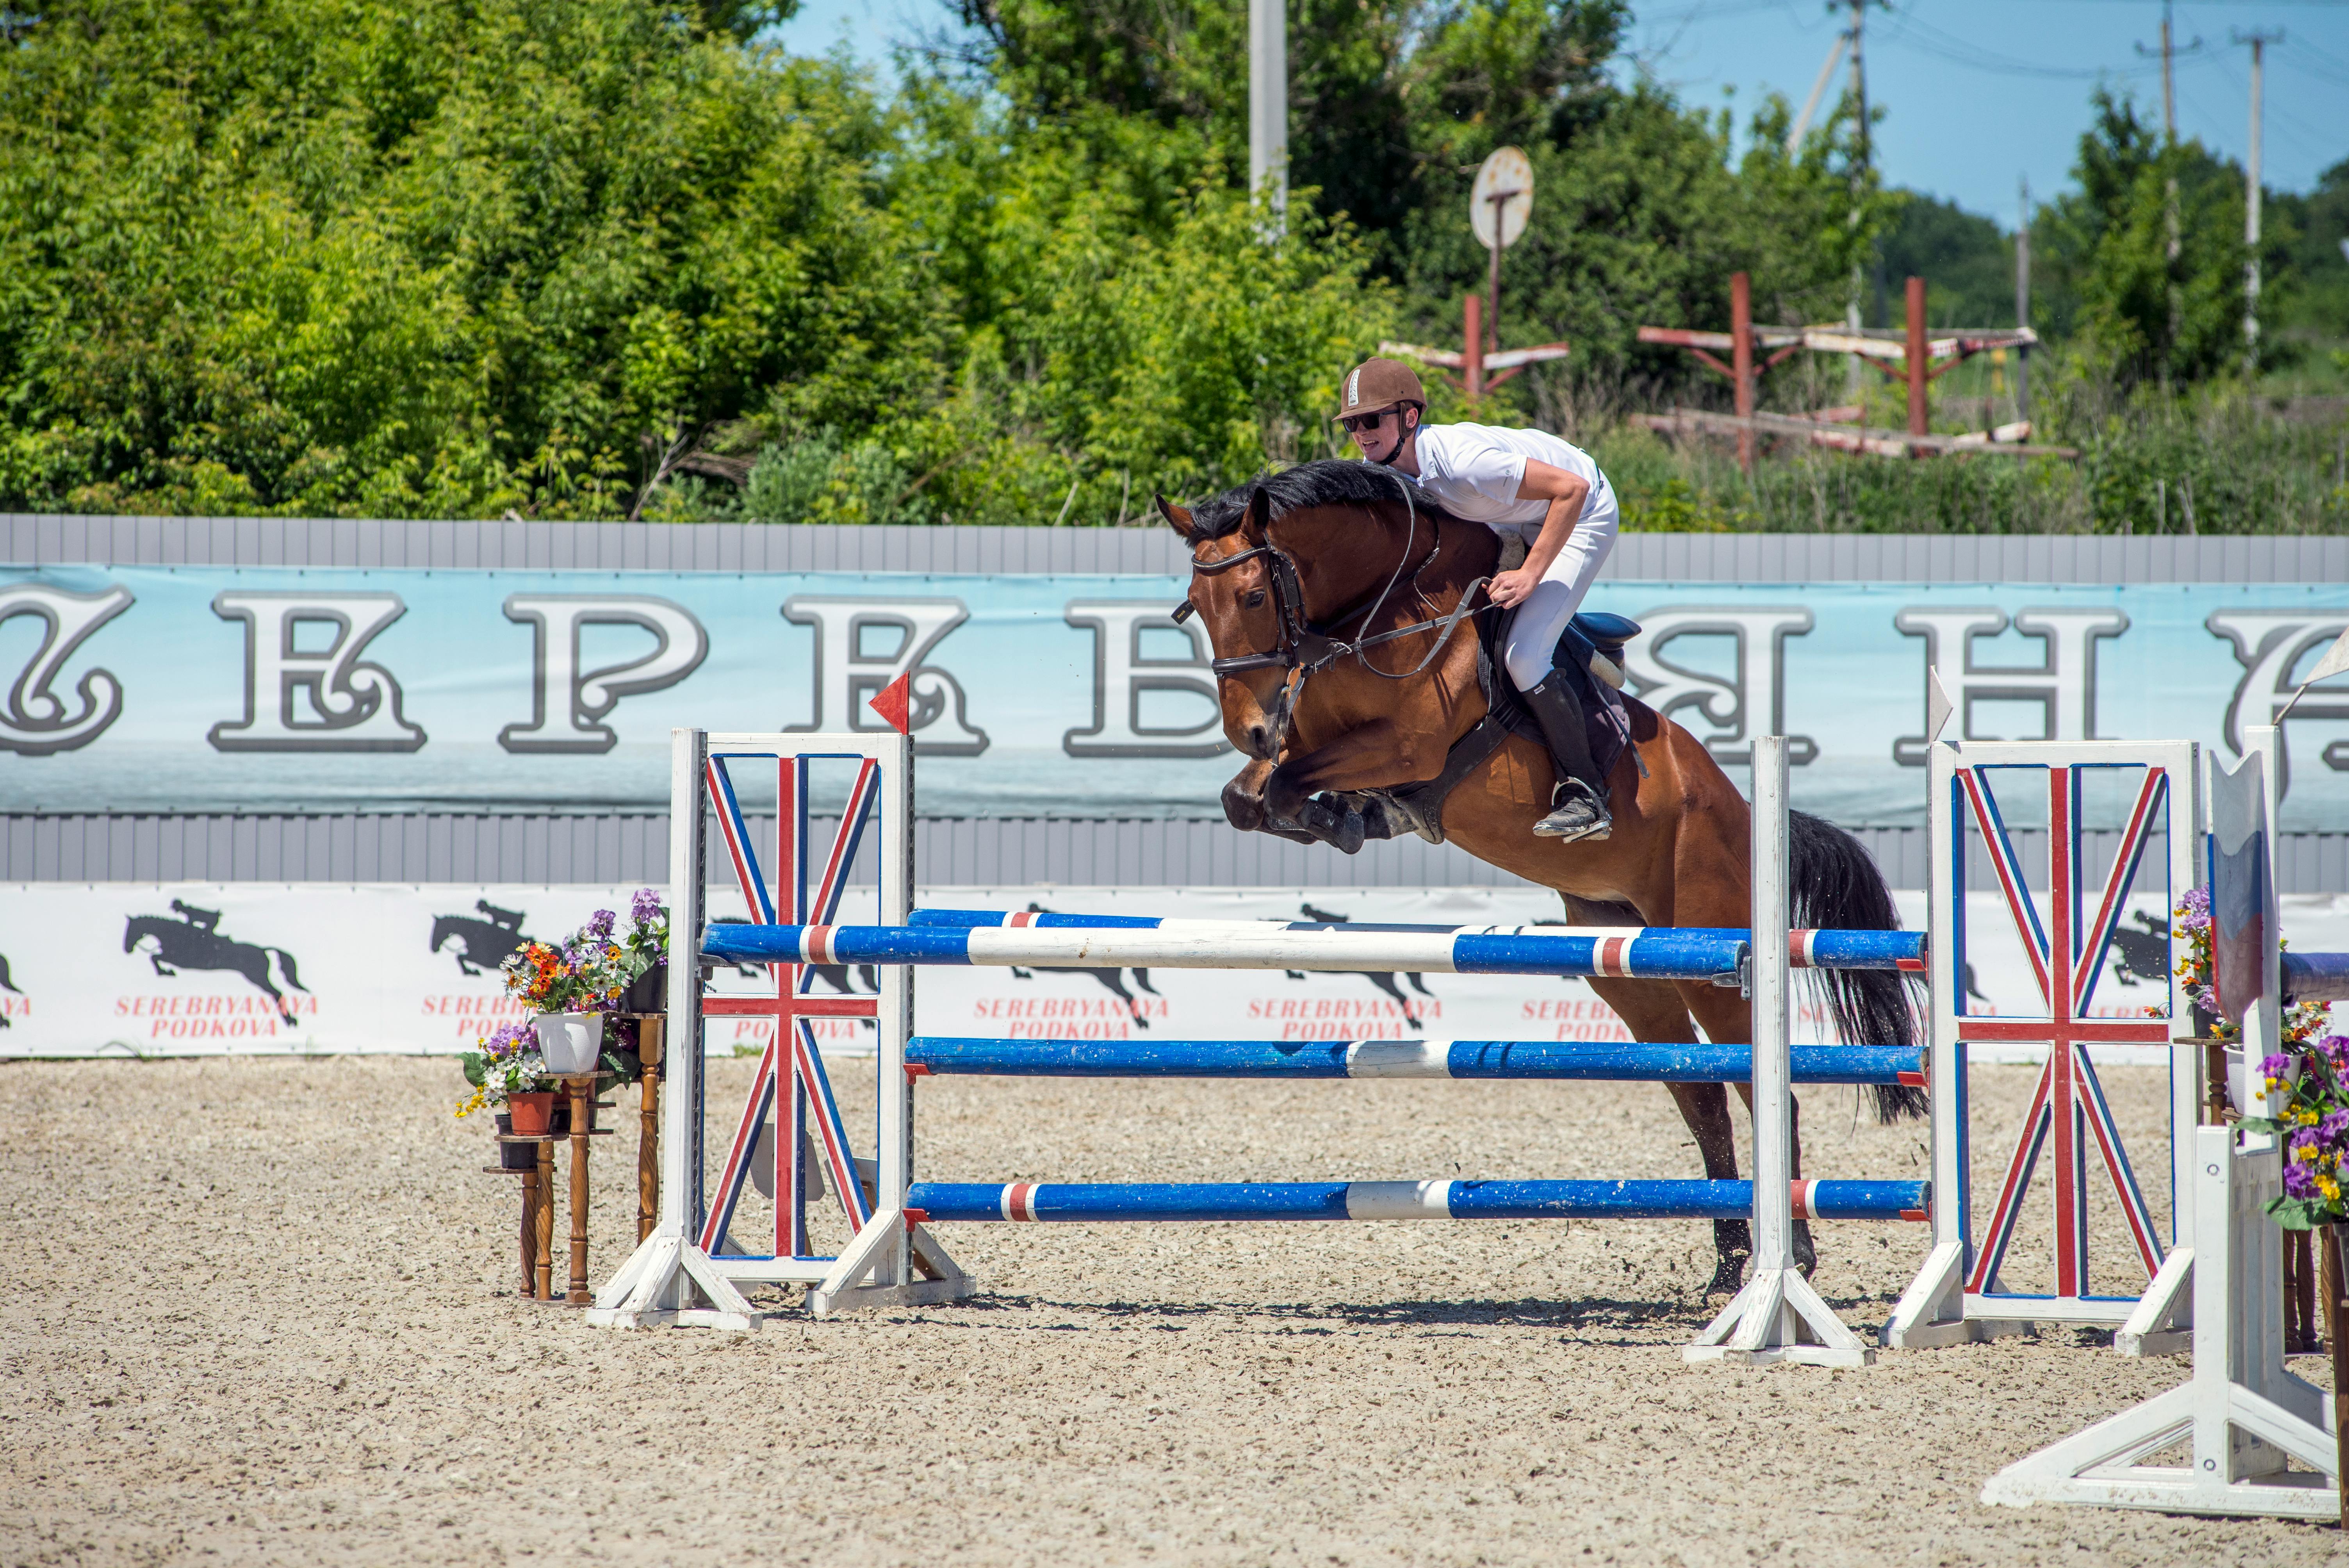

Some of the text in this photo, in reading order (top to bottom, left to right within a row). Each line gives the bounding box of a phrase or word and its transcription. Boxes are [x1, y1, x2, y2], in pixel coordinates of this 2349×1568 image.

[114, 994, 318, 1017] SEREBRYANAYA
[974, 997, 1169, 1018] SEREBRYANAYA
[1248, 998, 1442, 1019] SEREBRYANAYA
[150, 1017, 277, 1039] PODKOVA
[734, 1019, 855, 1040] POOVA
[1009, 1020, 1129, 1039] PODKOVA
[1282, 1021, 1403, 1040] PODKOVA
